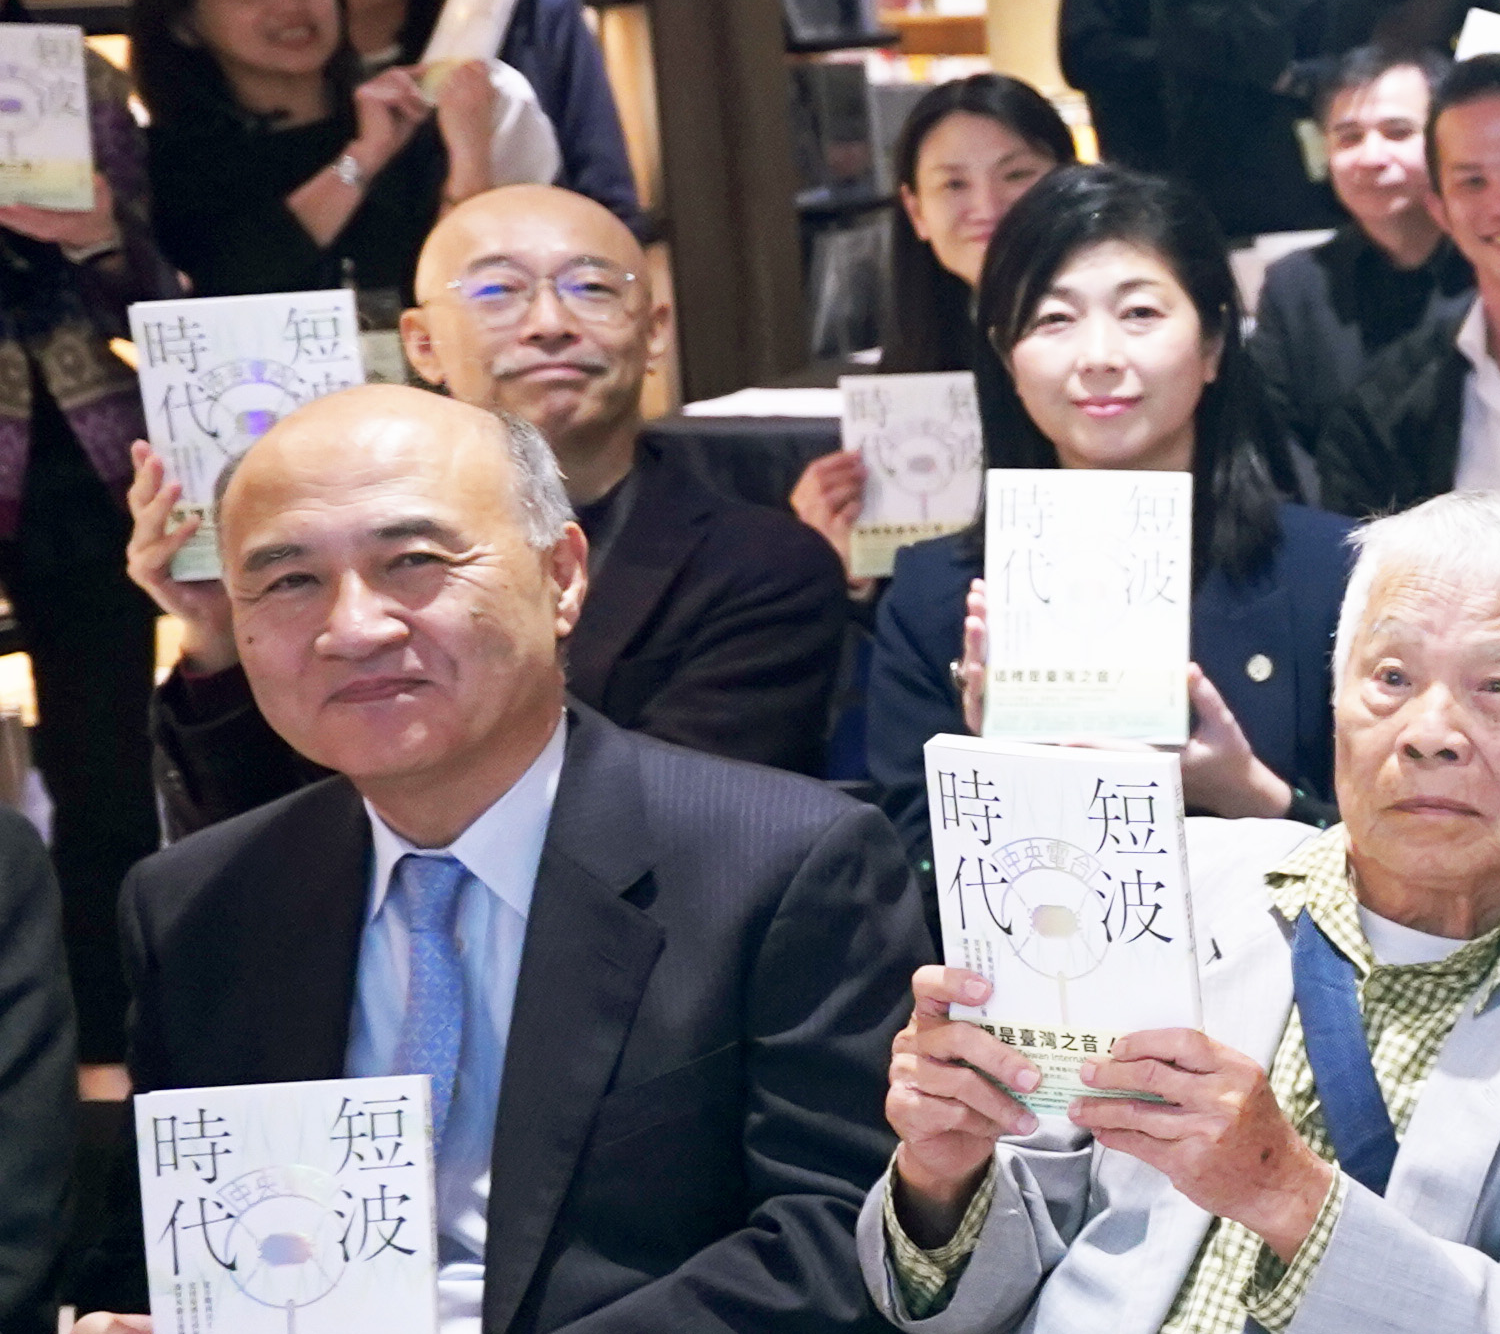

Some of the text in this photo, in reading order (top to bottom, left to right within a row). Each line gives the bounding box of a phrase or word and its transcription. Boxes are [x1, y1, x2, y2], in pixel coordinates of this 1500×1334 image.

[144, 316, 219, 443] 時代
[1000, 484, 1054, 605] 時代
[1124, 484, 1181, 605] 短波
[937, 768, 1013, 936] 時代
[1088, 777, 1174, 945] 短波
[153, 1107, 238, 1276] 時代
[330, 1095, 417, 1263] 短波
